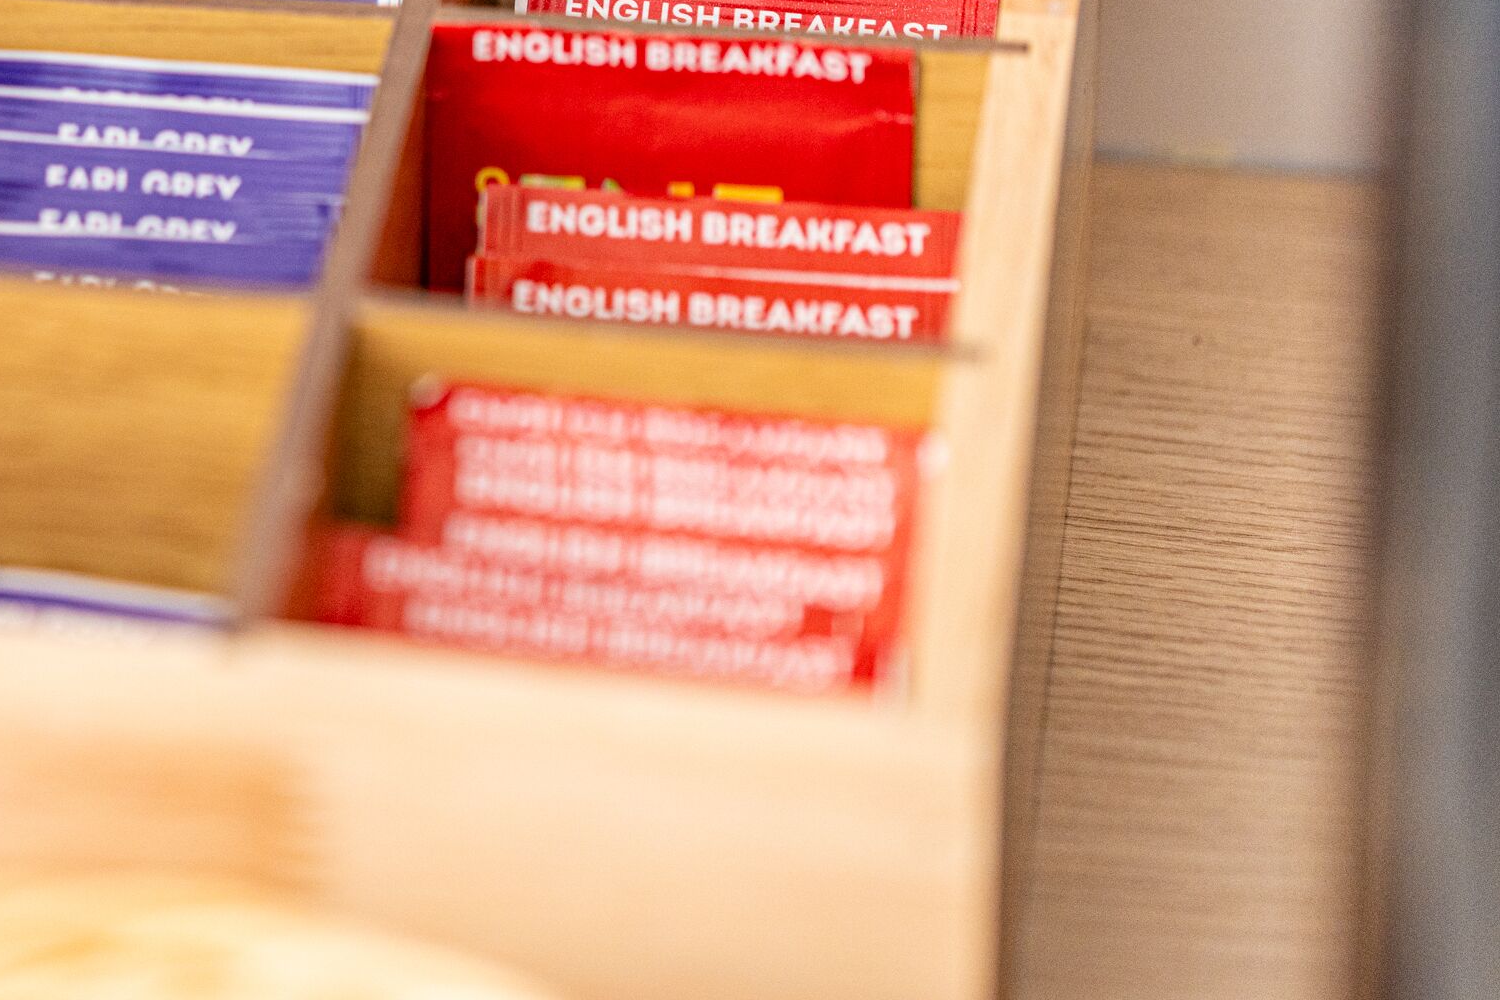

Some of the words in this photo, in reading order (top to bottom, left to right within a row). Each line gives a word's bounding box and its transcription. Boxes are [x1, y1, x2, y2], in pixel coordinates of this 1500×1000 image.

[733, 7, 949, 42] BREAKFAST
[472, 31, 637, 69] ENGLISH
[646, 36, 873, 84] BREAKFAST
[526, 201, 692, 242] ENGLISH
[701, 211, 931, 257] BREAKFAST
[512, 278, 678, 323] ENGLISH
[687, 290, 919, 340] BREAKFAST
